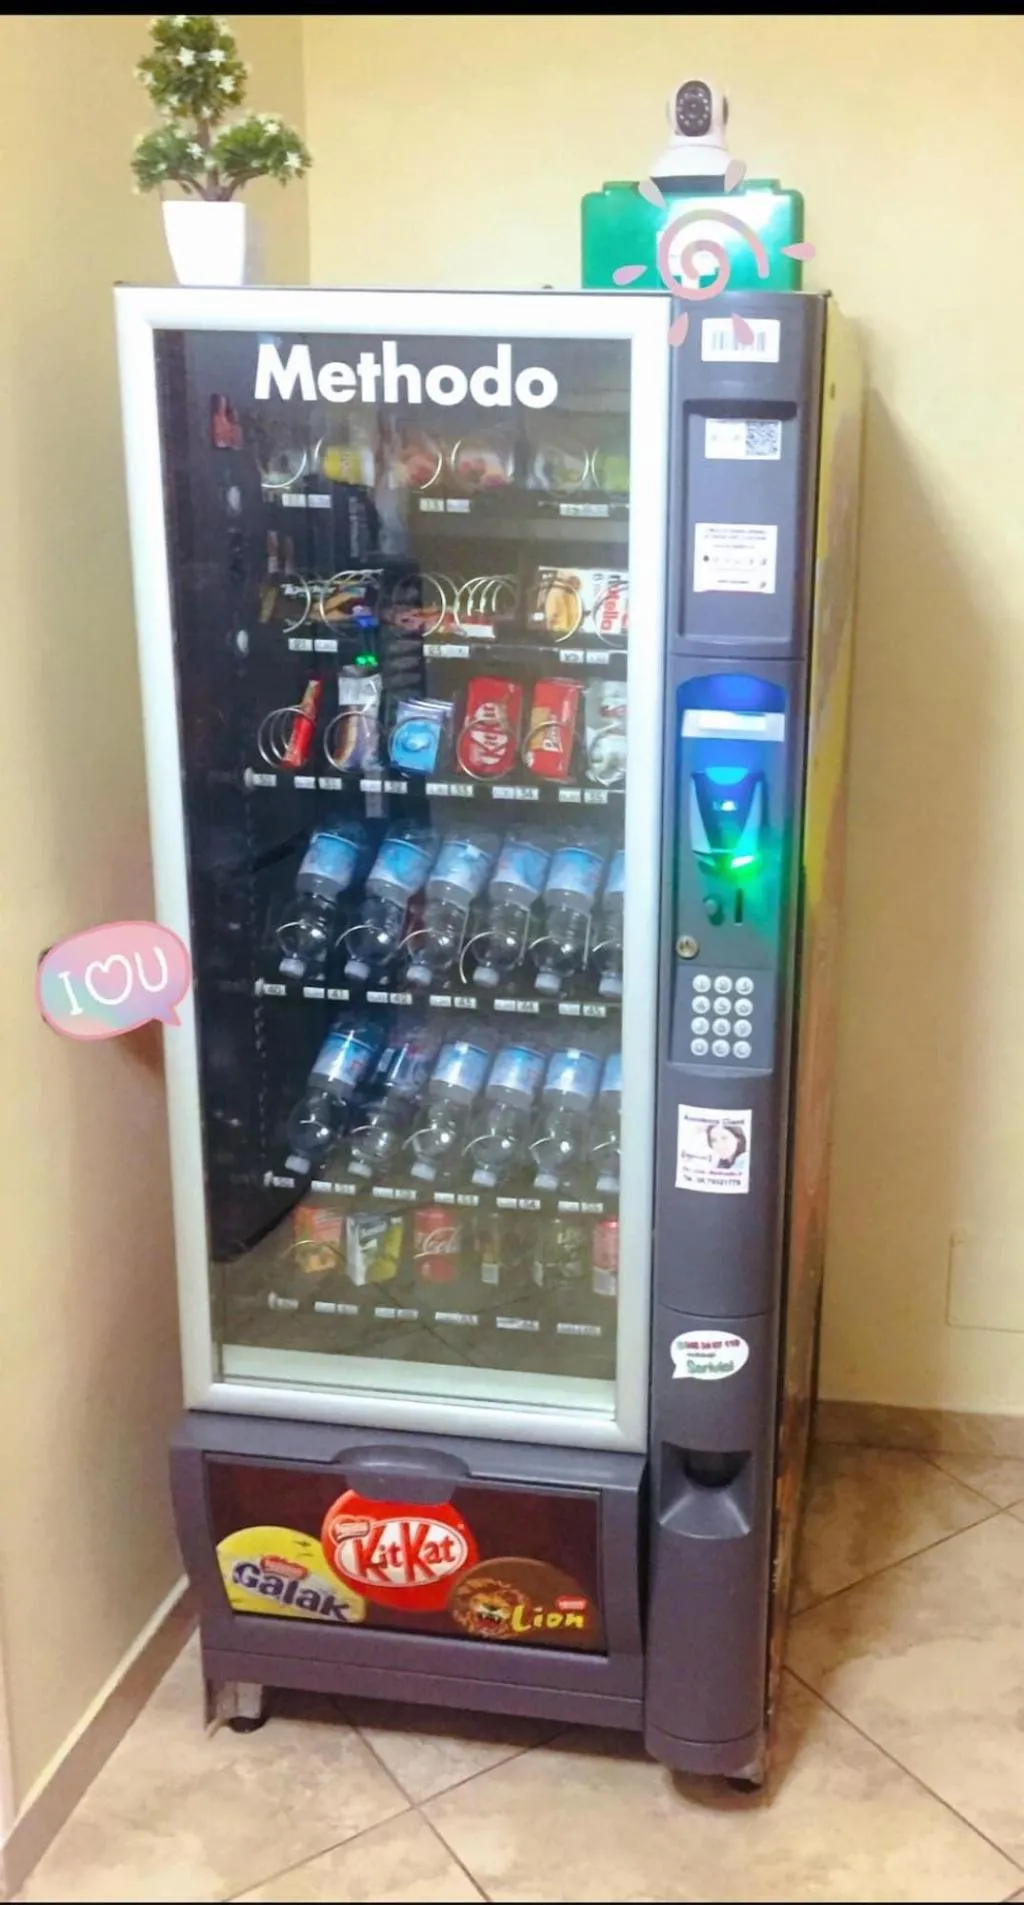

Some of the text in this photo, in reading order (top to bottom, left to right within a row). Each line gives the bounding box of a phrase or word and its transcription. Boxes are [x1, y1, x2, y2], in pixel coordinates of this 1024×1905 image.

[254, 341, 559, 409] Methodo
[352, 1520, 457, 1582] KitKat
[232, 1562, 350, 1622] Galak
[511, 1603, 585, 1633] Lion
